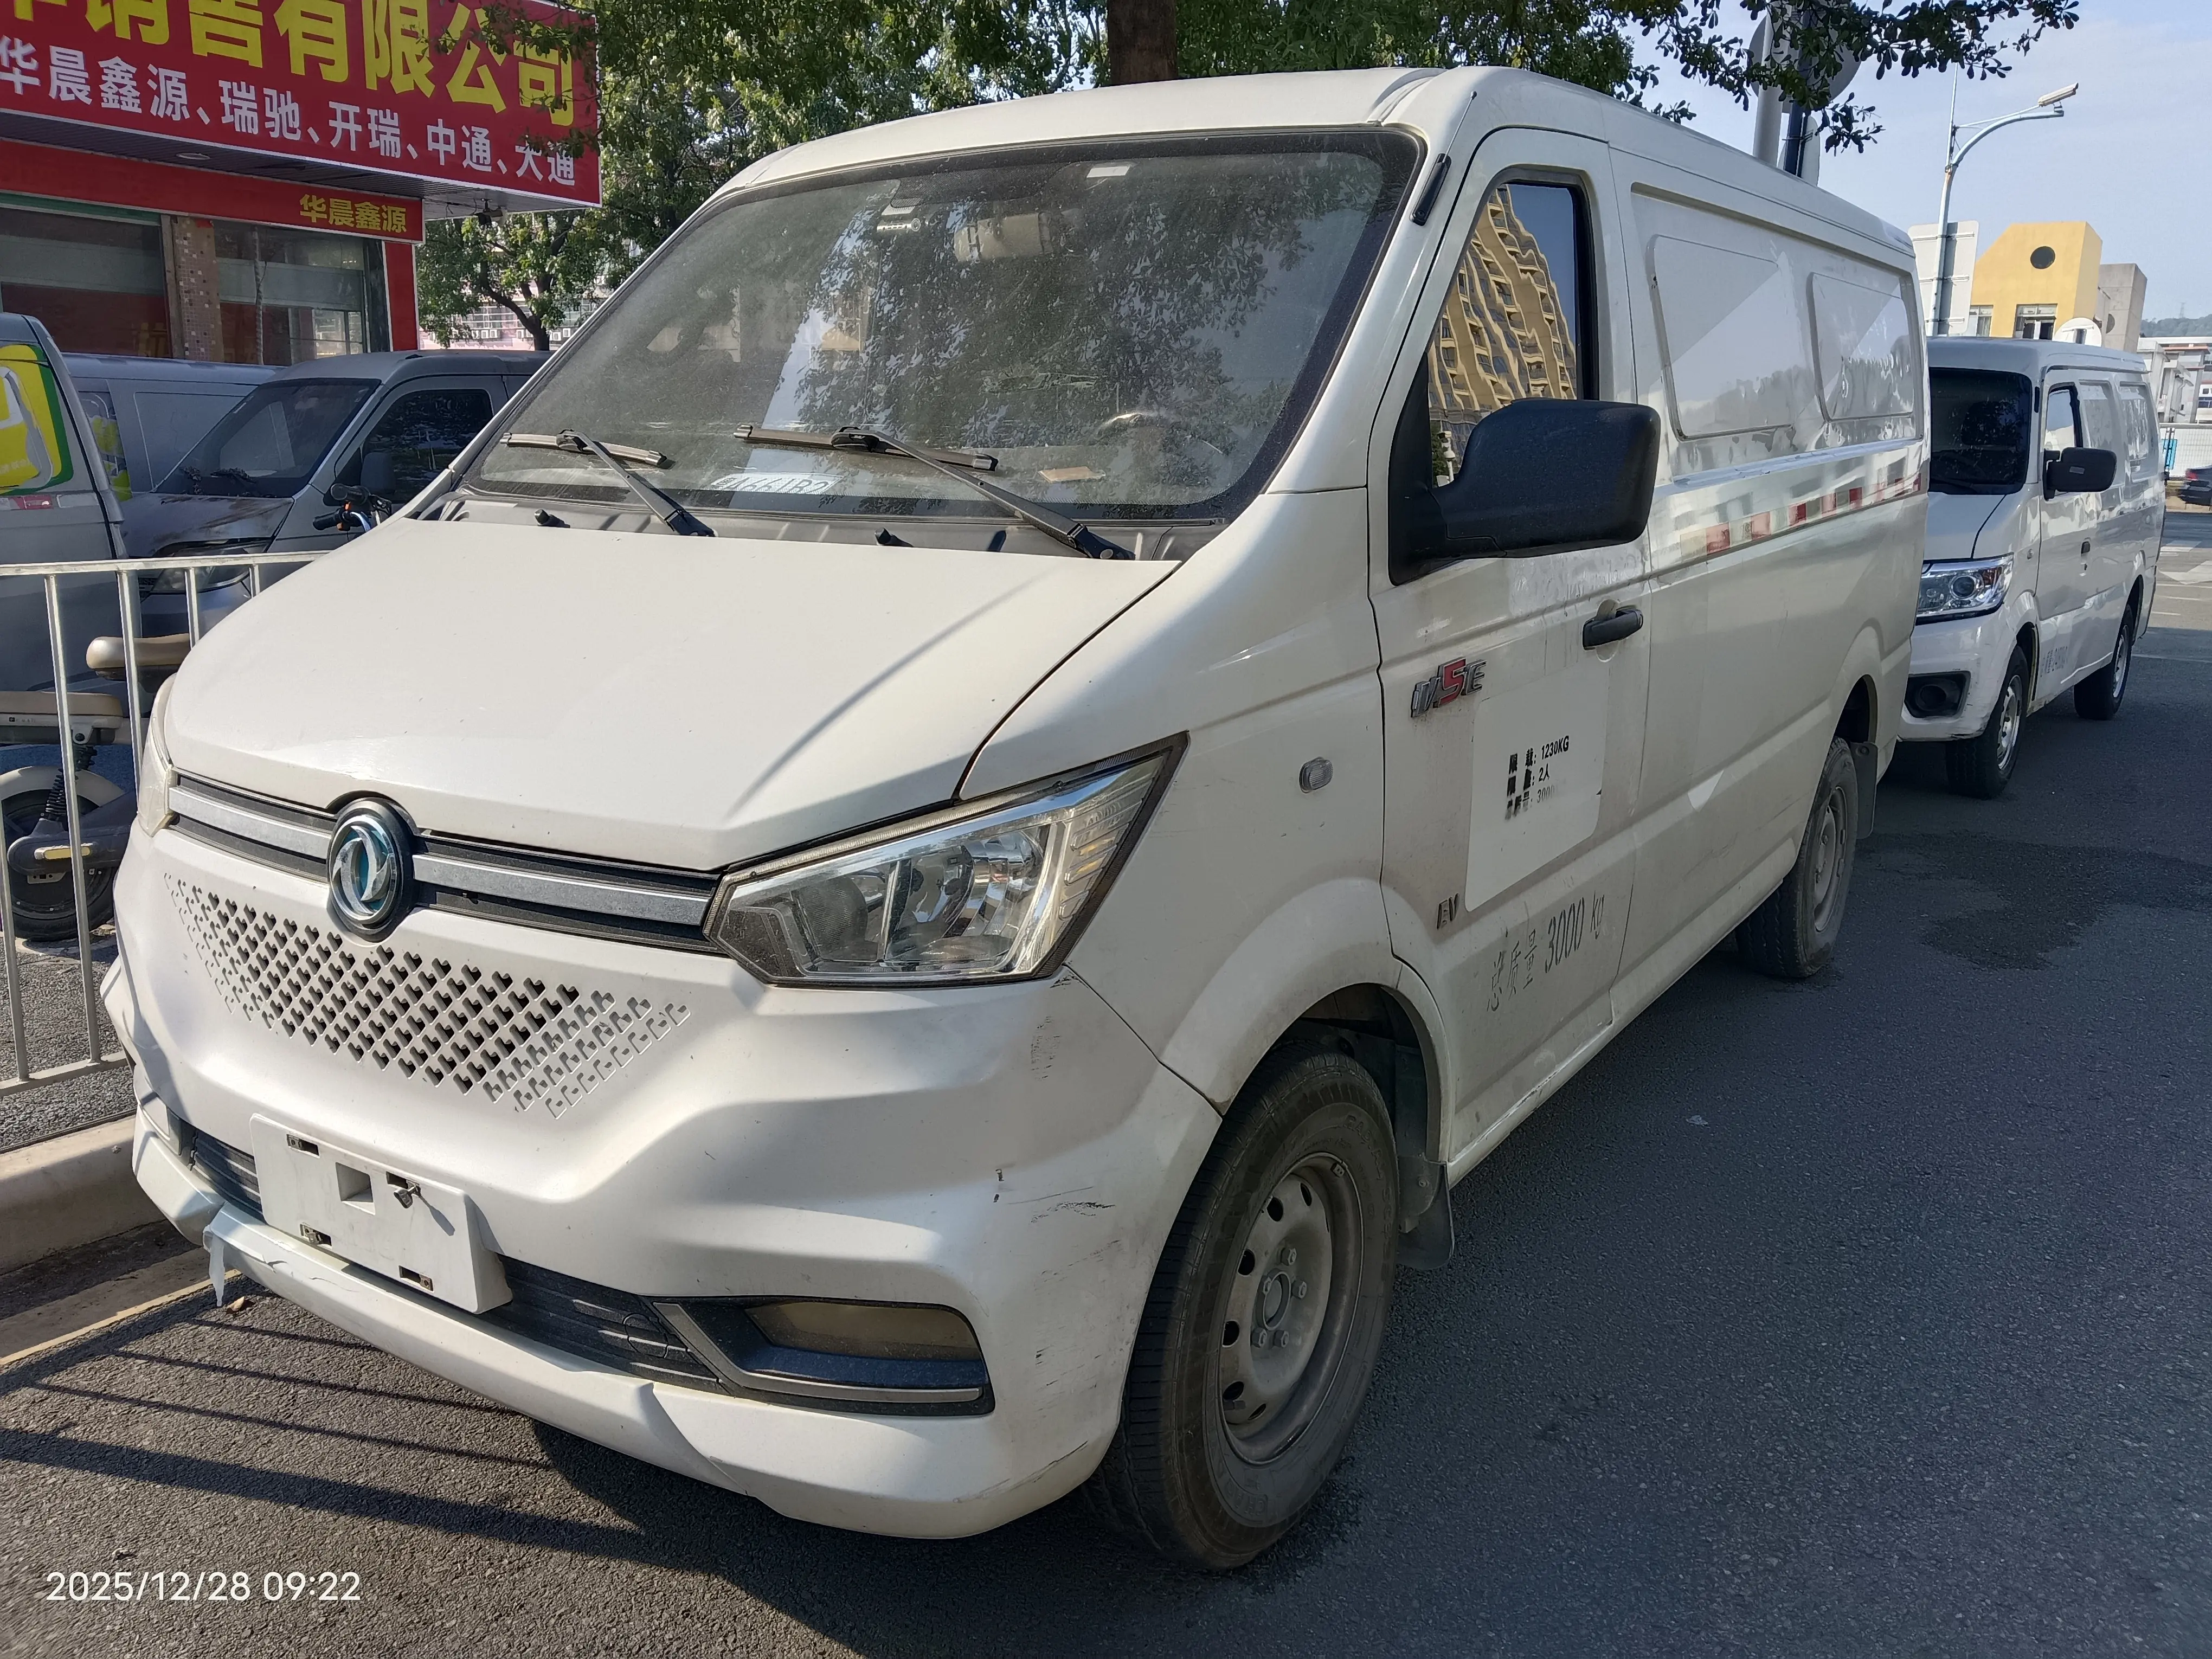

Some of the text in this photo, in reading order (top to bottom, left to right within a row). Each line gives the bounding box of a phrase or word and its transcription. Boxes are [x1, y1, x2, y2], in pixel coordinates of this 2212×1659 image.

[299, 194, 407, 233] 华晨鑫源
[1541, 736, 1569, 760] 1230KG
[1437, 893, 1459, 929] EV
[1545, 897, 1584, 973] 3000
